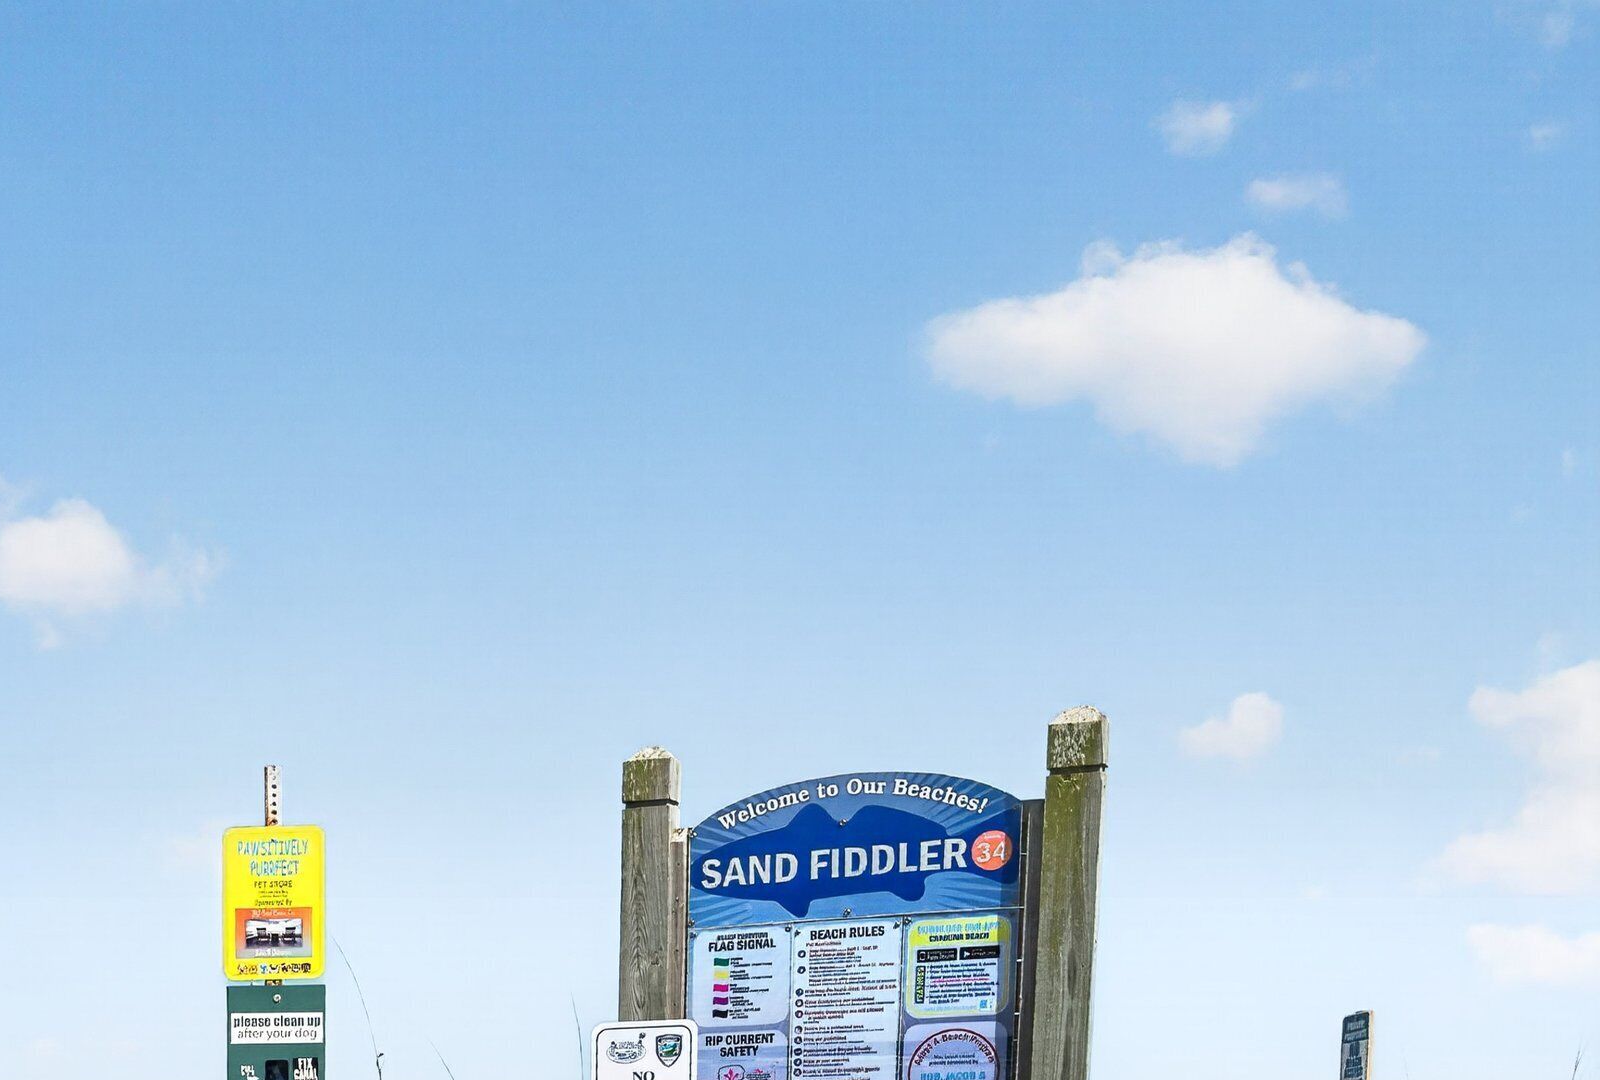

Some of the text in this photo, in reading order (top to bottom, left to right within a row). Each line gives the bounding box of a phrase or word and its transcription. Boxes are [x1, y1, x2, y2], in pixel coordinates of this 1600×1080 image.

[717, 778, 989, 831] Welcome to Our Beaches!
[237, 838, 308, 856] PAWSITIVELY
[976, 841, 1005, 863] 34
[250, 859, 300, 876] PURRFECT
[701, 838, 967, 889] SAND FIDDLER
[810, 926, 885, 940] BEACH RULES
[708, 938, 776, 952] FLAG SIGNAL
[233, 1016, 321, 1027] please clean up
[237, 1028, 317, 1040] after your dog
[705, 1033, 775, 1046] RIP CURRENT
[720, 1045, 759, 1057] SAFETY
